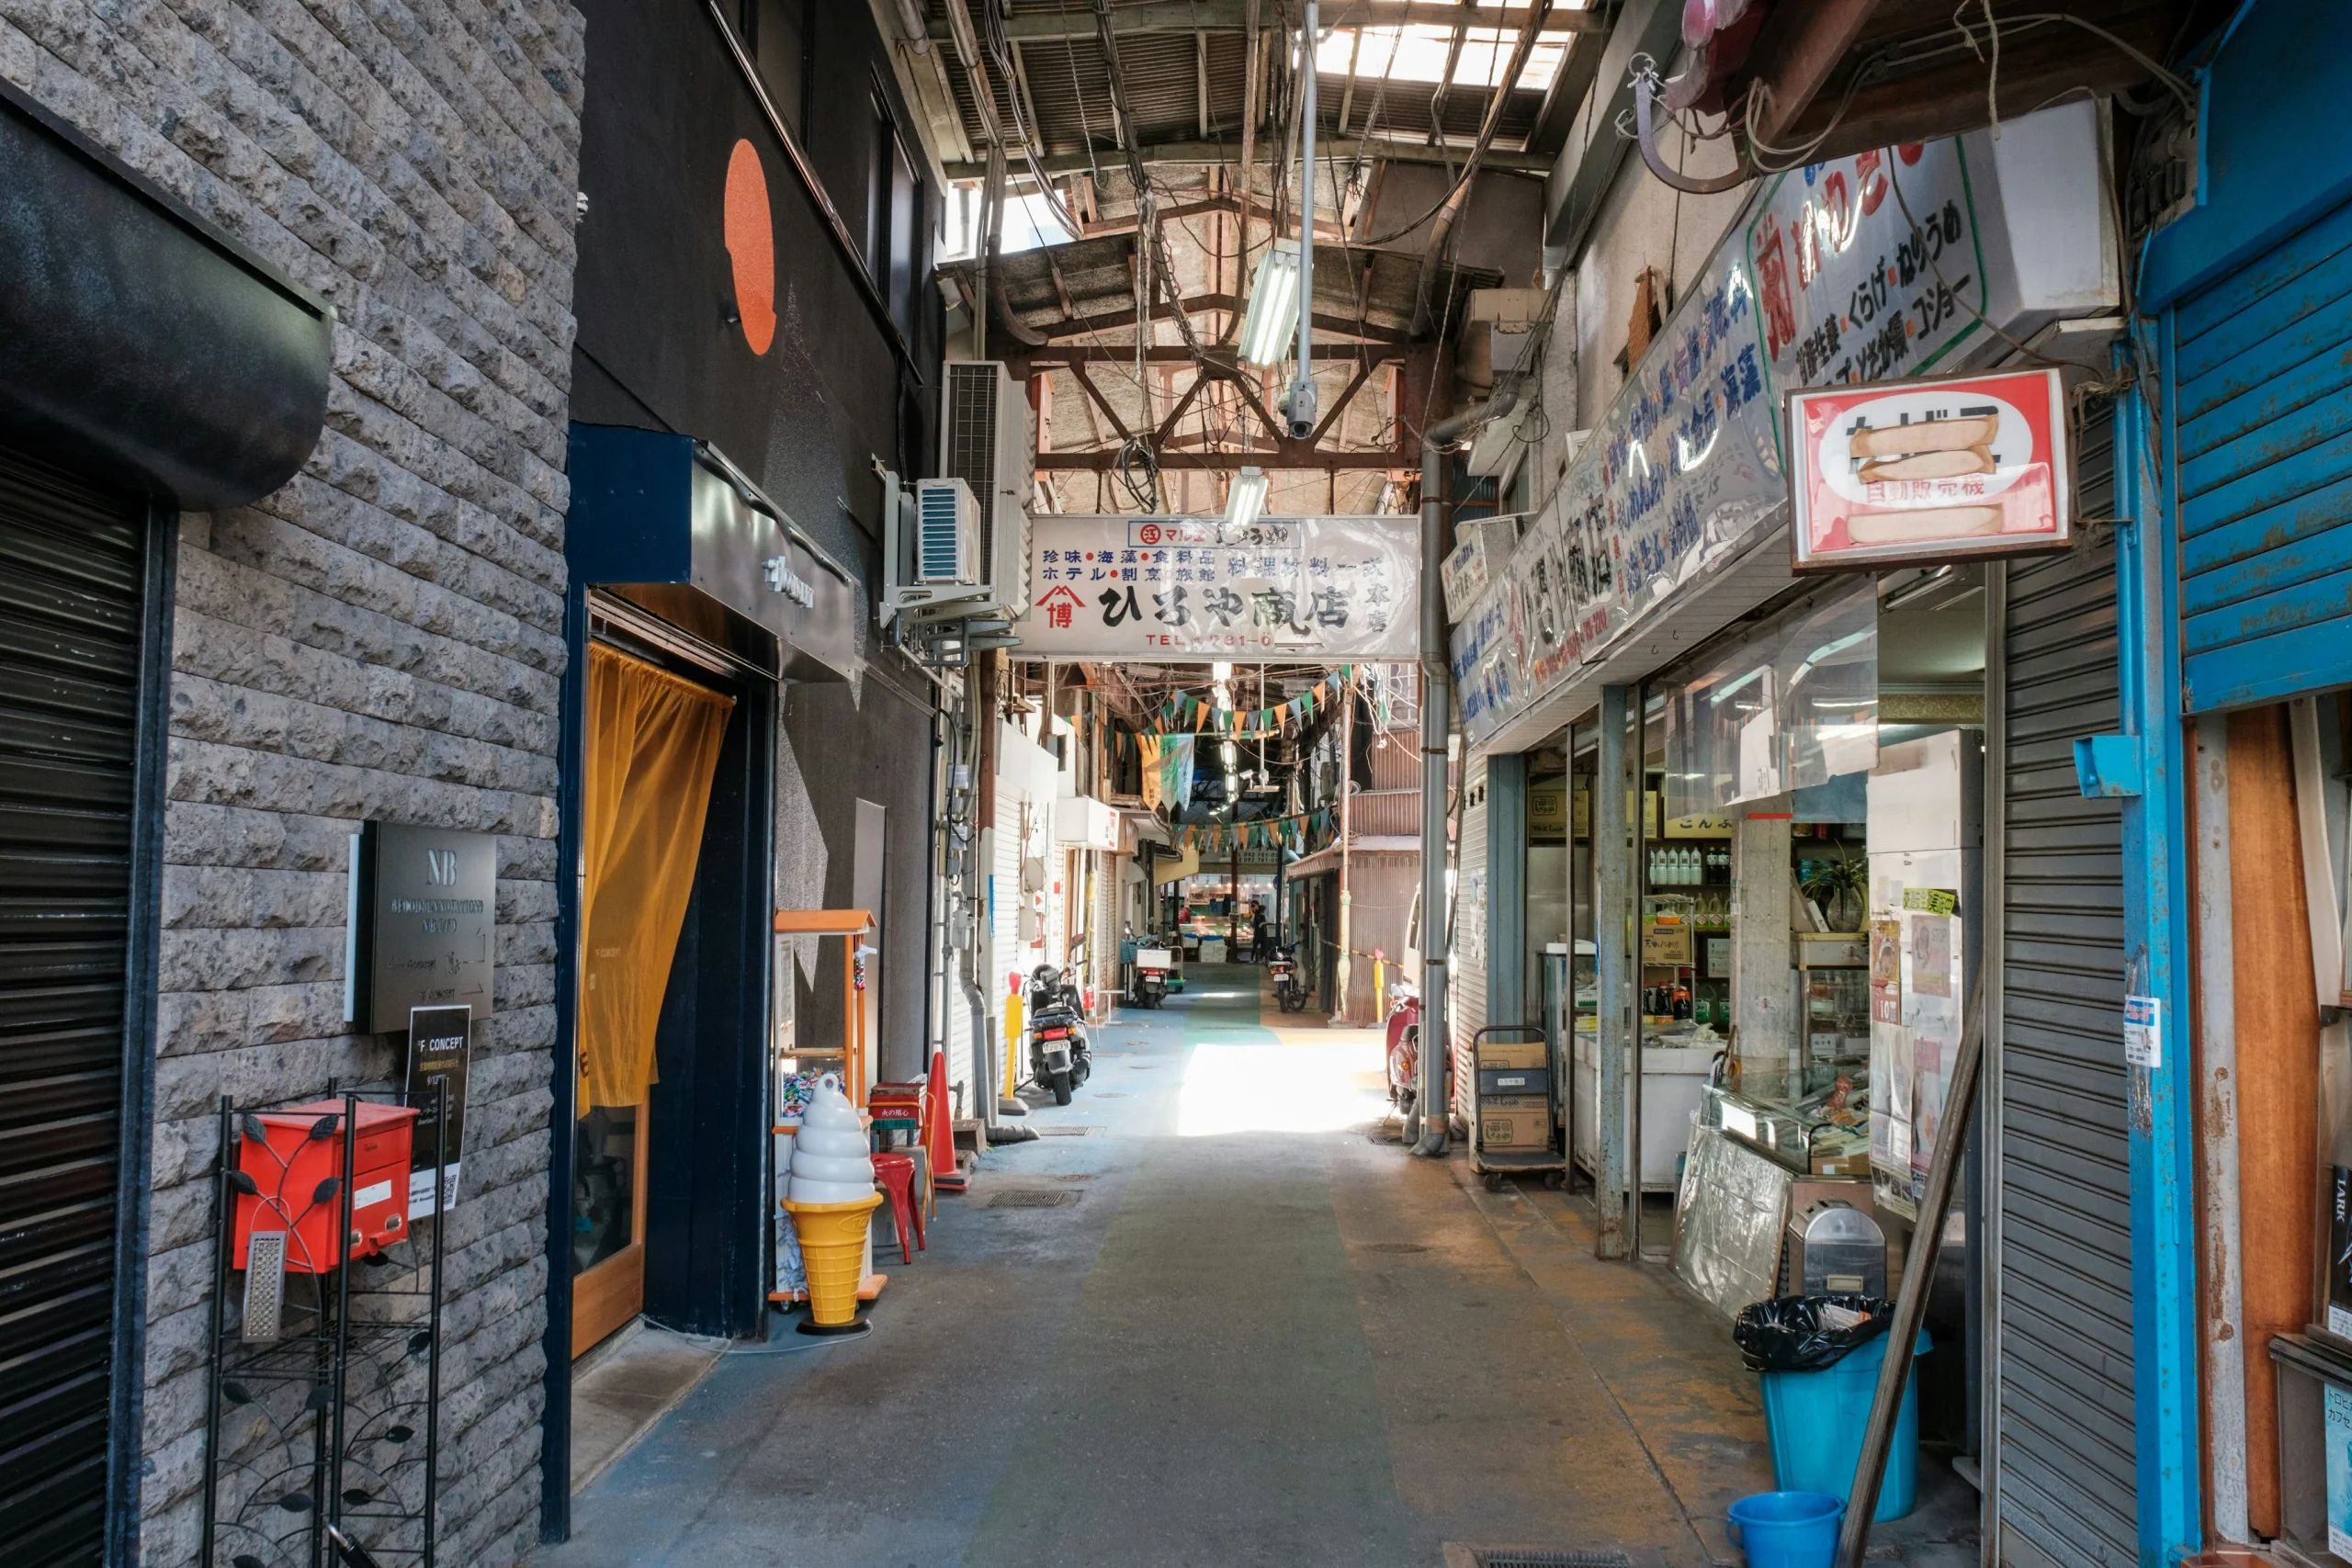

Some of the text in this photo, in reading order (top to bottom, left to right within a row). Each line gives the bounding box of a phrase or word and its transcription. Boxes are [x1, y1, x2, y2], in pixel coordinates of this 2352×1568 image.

[1043, 550, 1216, 564] 珍味・海藻・食料品
[1046, 585, 1350, 628] 博 ひろや商店
[1367, 583, 1391, 633] 本店
[427, 849, 457, 886] NB
[429, 1036, 464, 1052] CONCEPT
[882, 1109, 909, 1117] 火の用心
[2336, 1179, 2346, 1224] LARK
